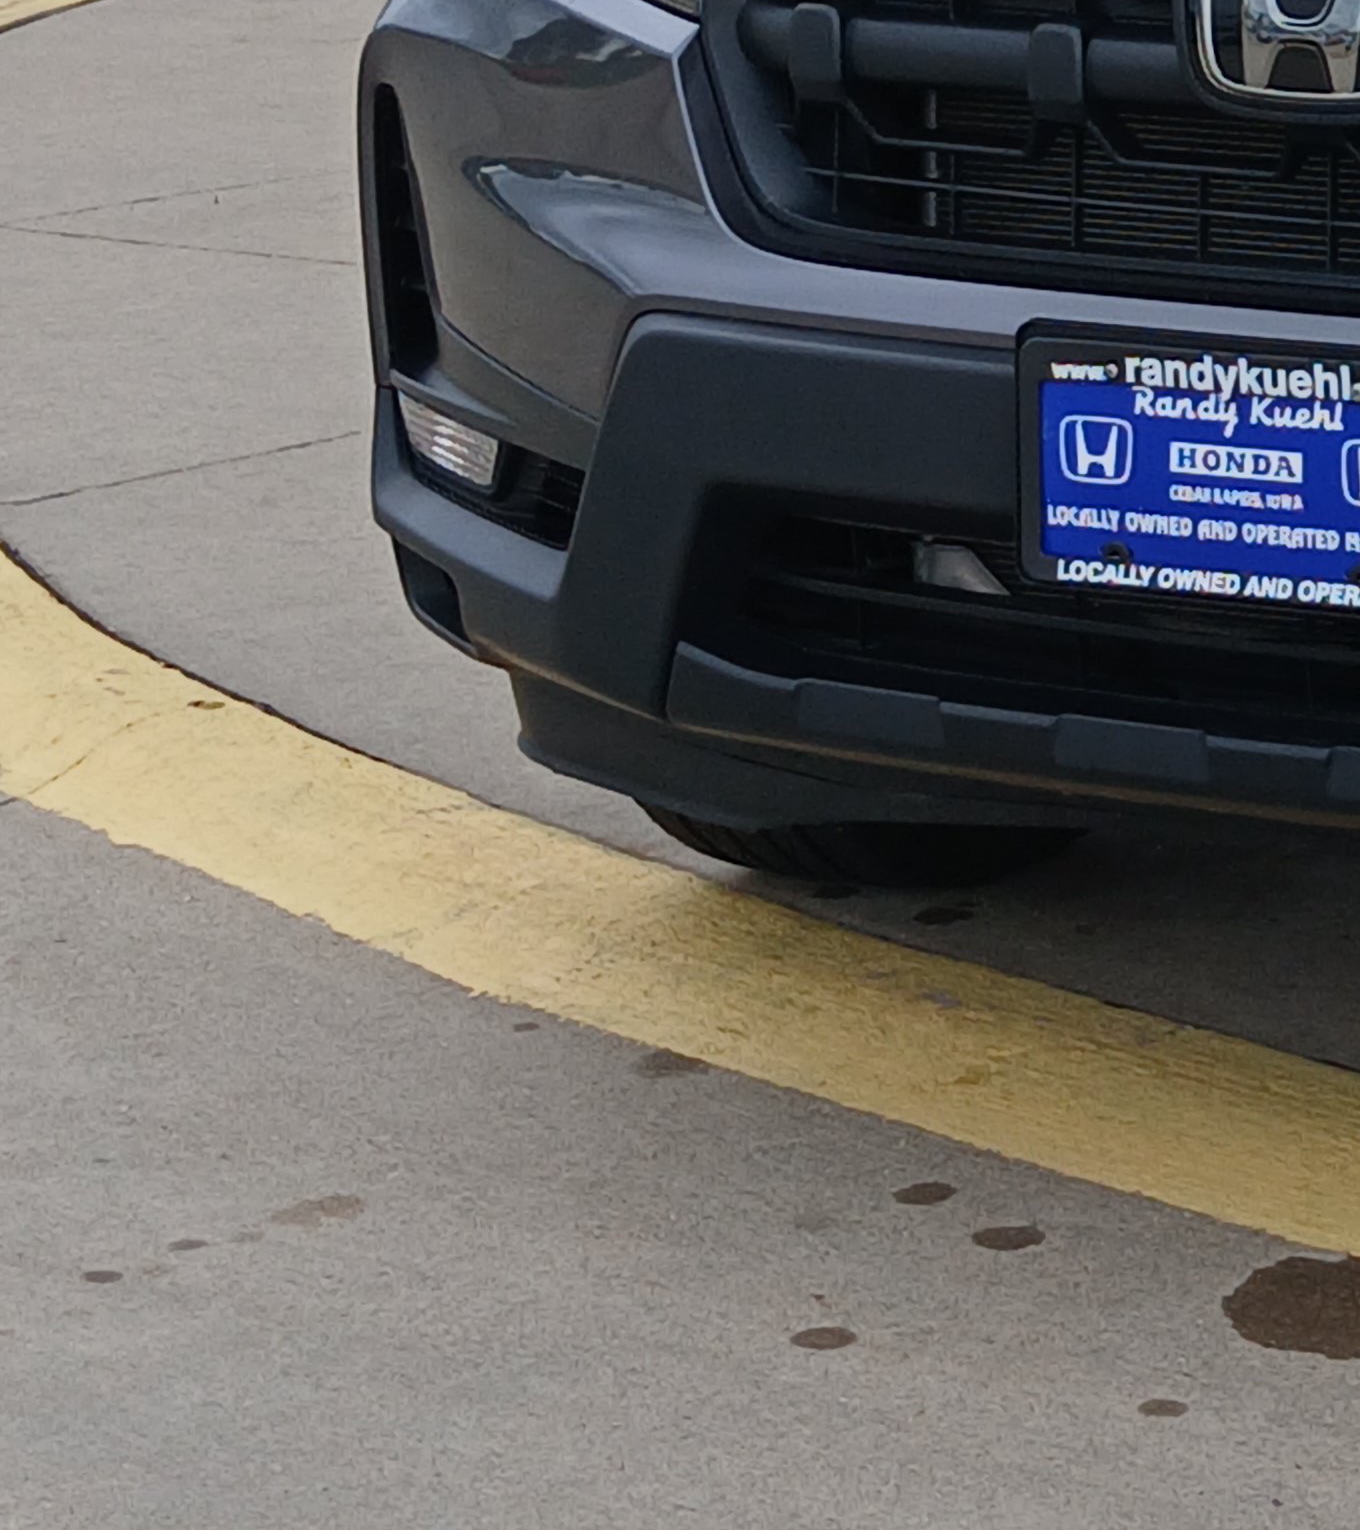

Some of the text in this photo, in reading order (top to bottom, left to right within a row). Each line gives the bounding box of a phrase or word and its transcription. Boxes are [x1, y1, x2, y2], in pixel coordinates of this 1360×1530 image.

[1125, 354, 1350, 402] randykuehl
[1132, 385, 1344, 438] Randy Kuehl
[1177, 447, 1296, 478] HONDA
[1047, 504, 1120, 532] LOCALLY
[1125, 512, 1193, 537] OWNED
[1197, 519, 1238, 541] AND
[1241, 522, 1340, 551] OPERATED
[1057, 558, 1155, 587] LOCALLY
[1157, 568, 1241, 595] OWNED
[1243, 575, 1293, 599] AND
